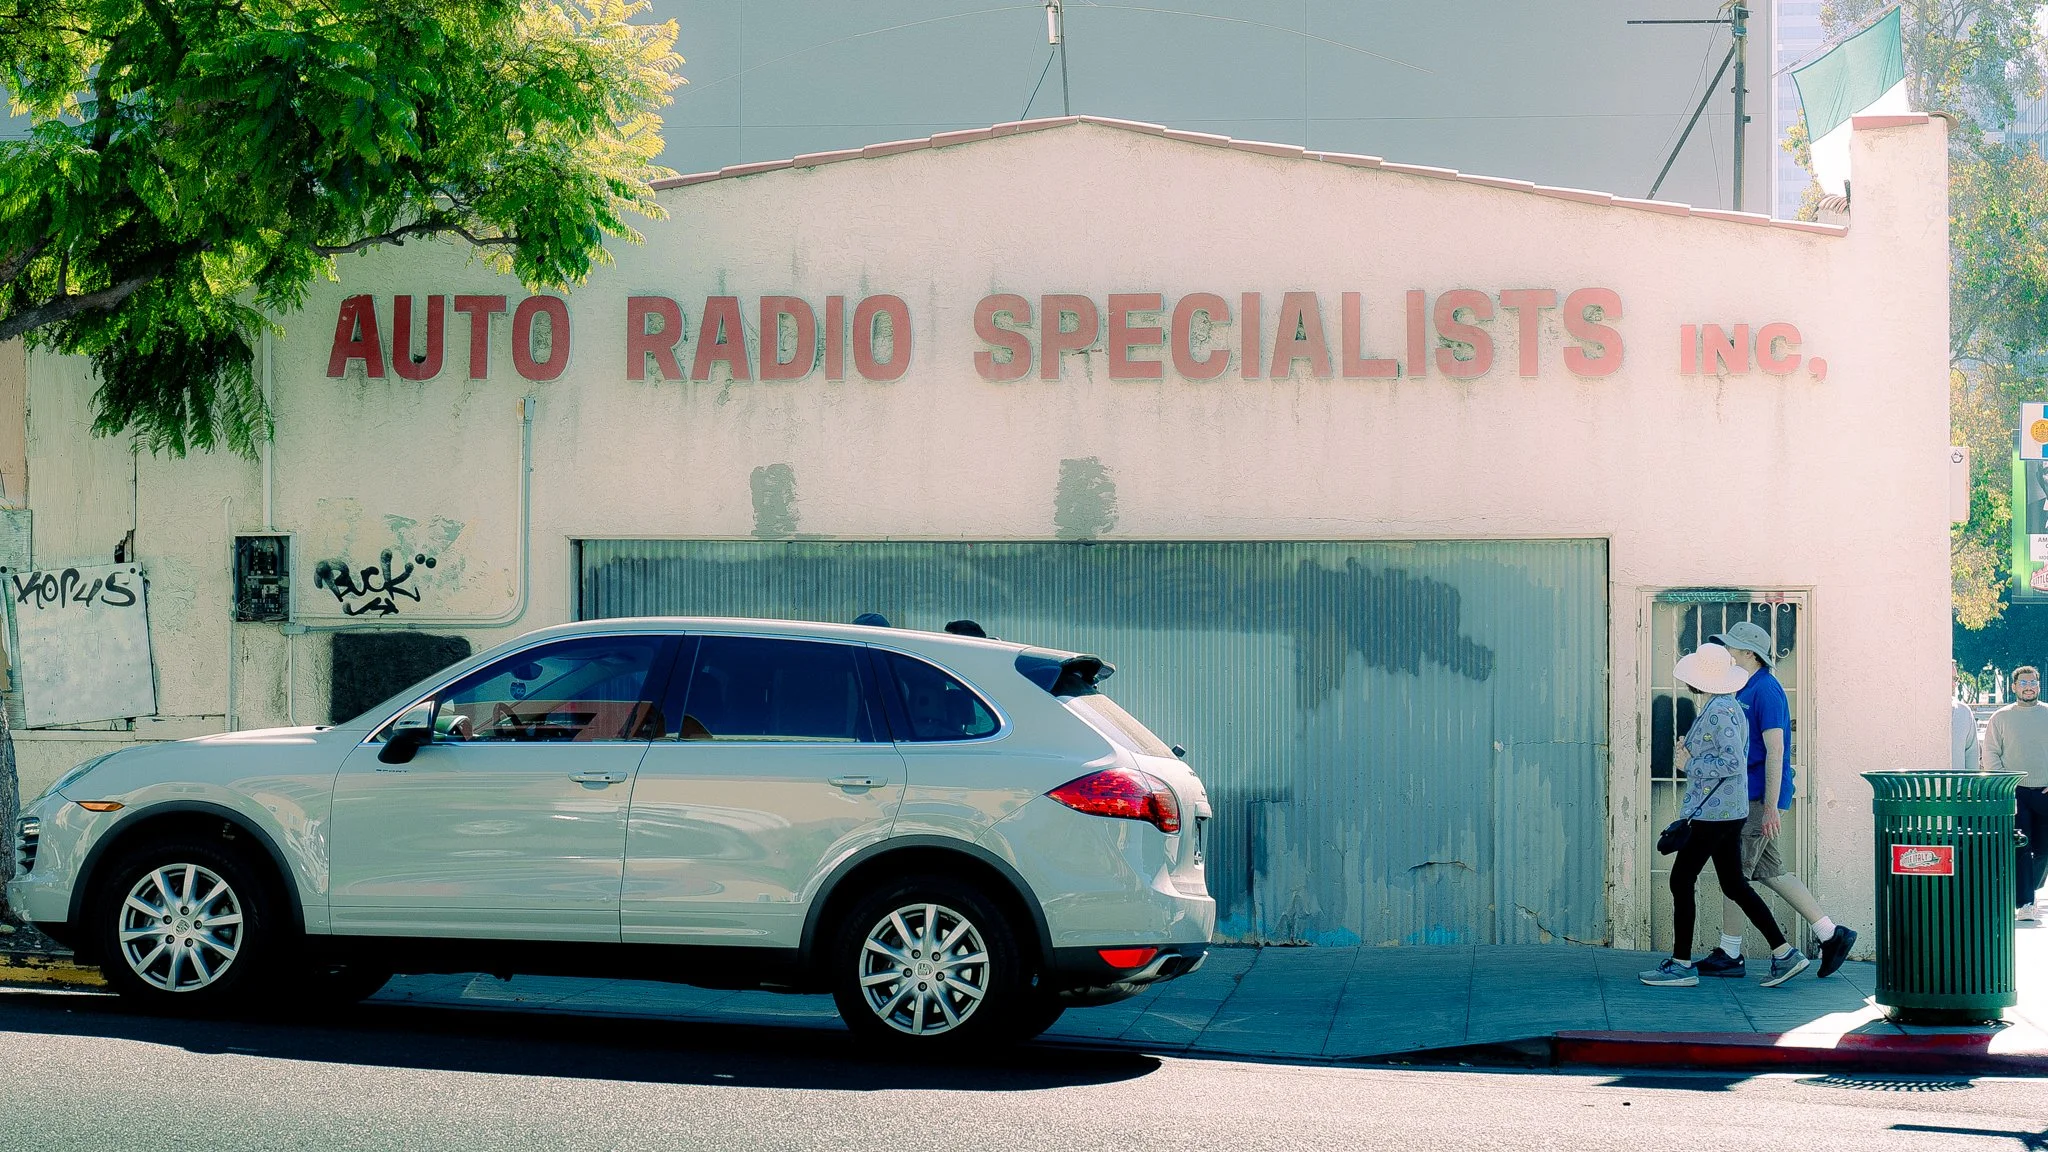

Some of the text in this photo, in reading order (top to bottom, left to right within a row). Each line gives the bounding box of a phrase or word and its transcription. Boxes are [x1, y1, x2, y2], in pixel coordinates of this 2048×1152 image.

[326, 294, 571, 382] AUTO
[626, 294, 912, 382] RADIO
[973, 288, 1624, 381] SPECIALISTS
